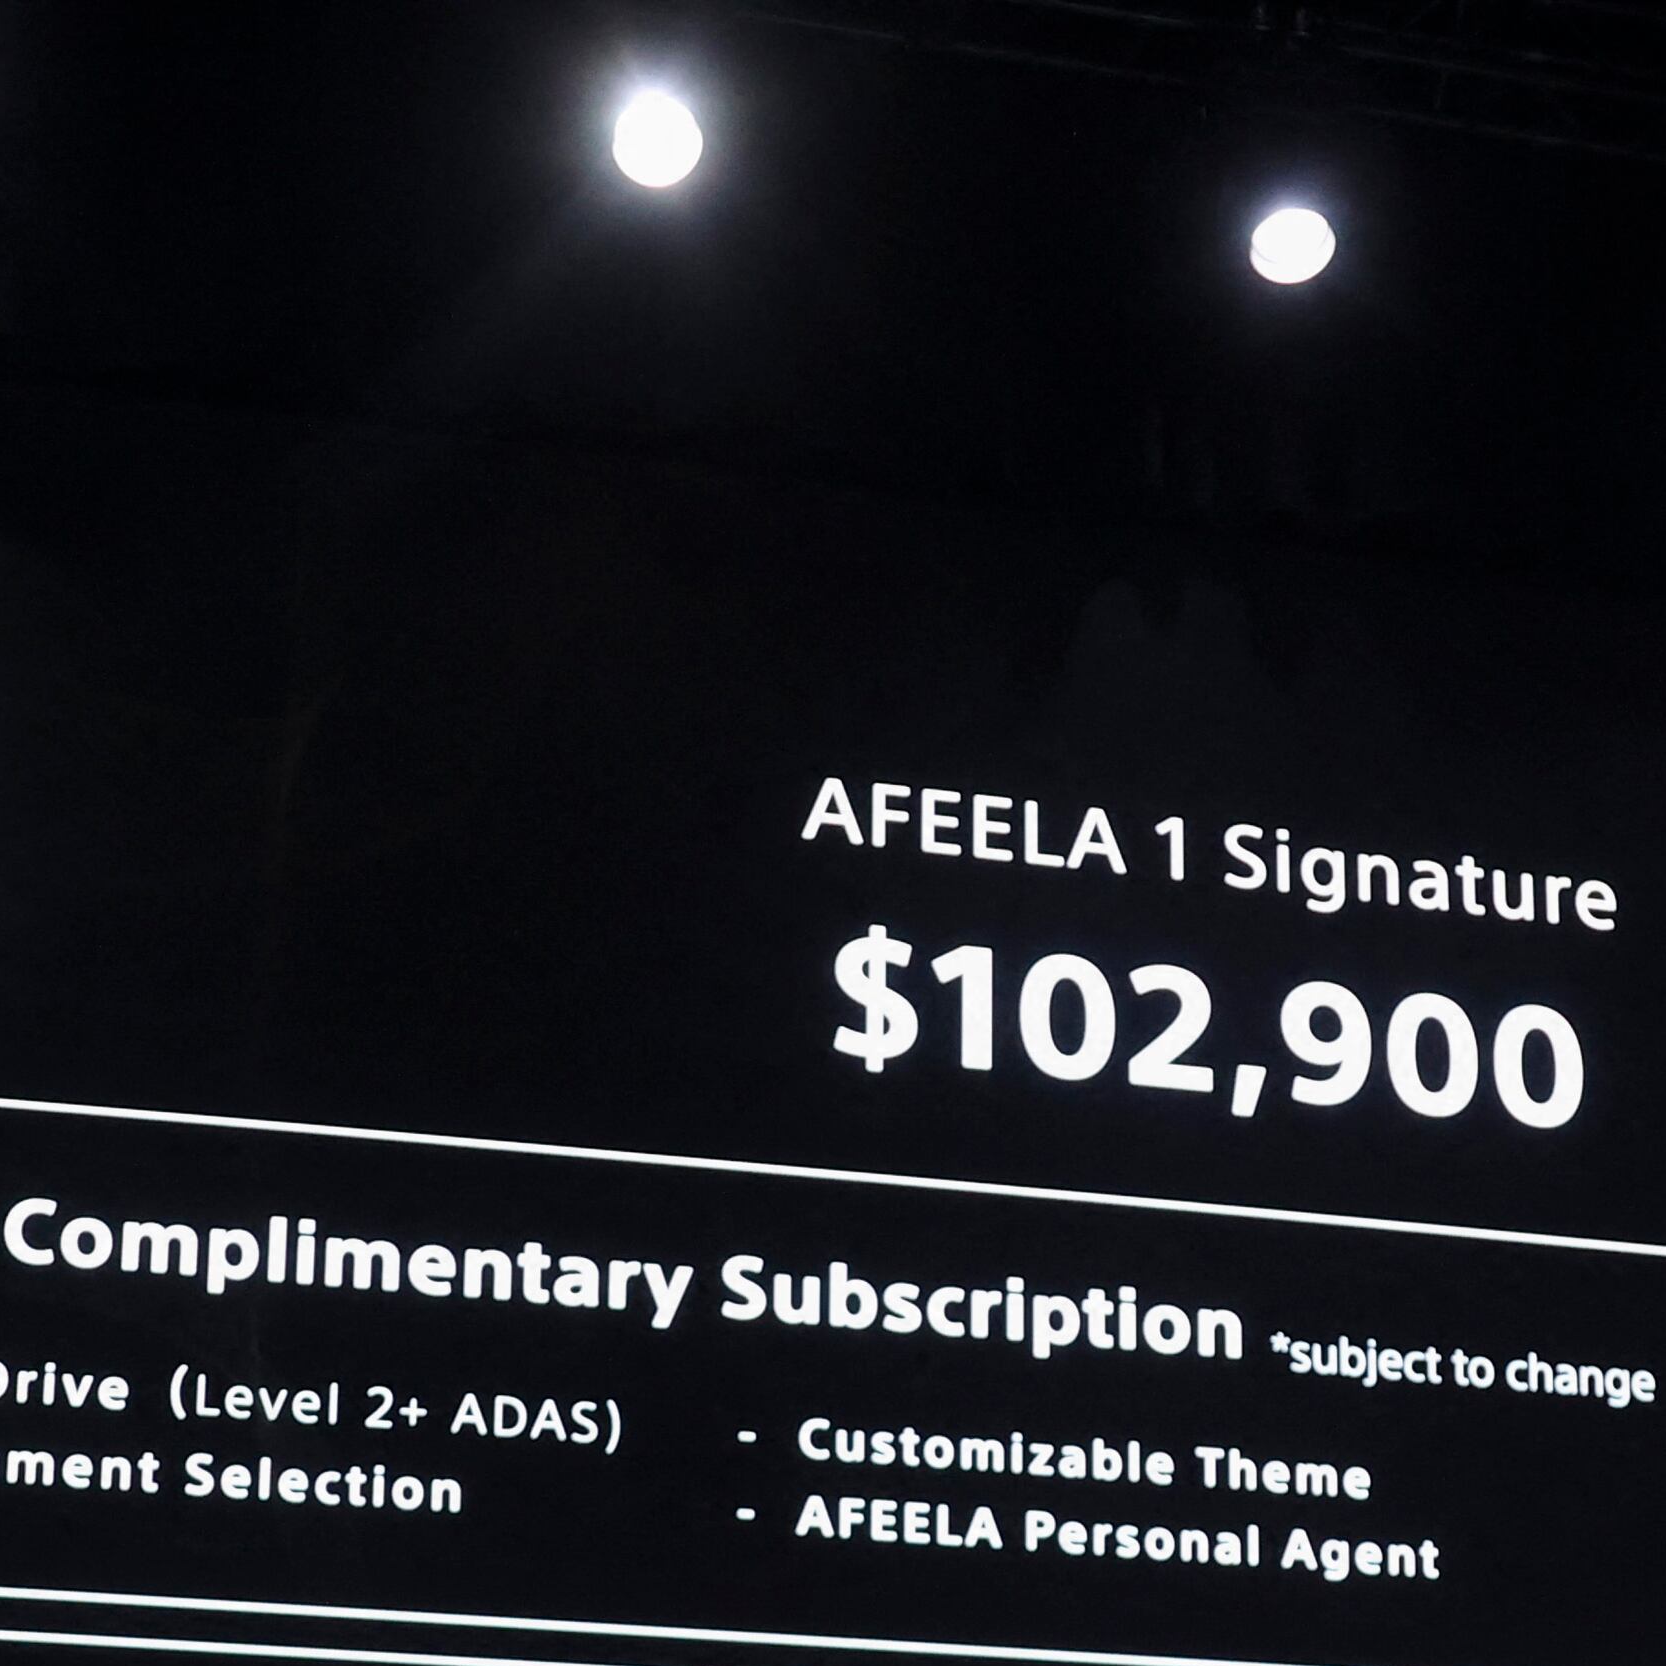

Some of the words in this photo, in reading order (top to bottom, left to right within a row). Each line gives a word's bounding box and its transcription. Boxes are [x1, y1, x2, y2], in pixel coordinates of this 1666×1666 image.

[801, 777, 1128, 875] AFEELA
[1154, 816, 1185, 881] 1
[1223, 823, 1617, 931] Signature
[833, 924, 1584, 1129] $102,900
[3, 1197, 694, 1329] Complimentary
[721, 1254, 1243, 1360] Subscription
[1450, 1348, 1495, 1389] to
[1505, 1351, 1656, 1408] change
[170, 1363, 339, 1425] (Level
[364, 1385, 428, 1429] 2+
[450, 1392, 621, 1455] ADAS)
[184, 1452, 462, 1513] Selection
[798, 1417, 1175, 1486] Customizable
[1194, 1446, 1371, 1500] Theme
[795, 1494, 1003, 1549] AFEELA
[1025, 1509, 1260, 1567] Personal
[1280, 1528, 1440, 1582] Agent
